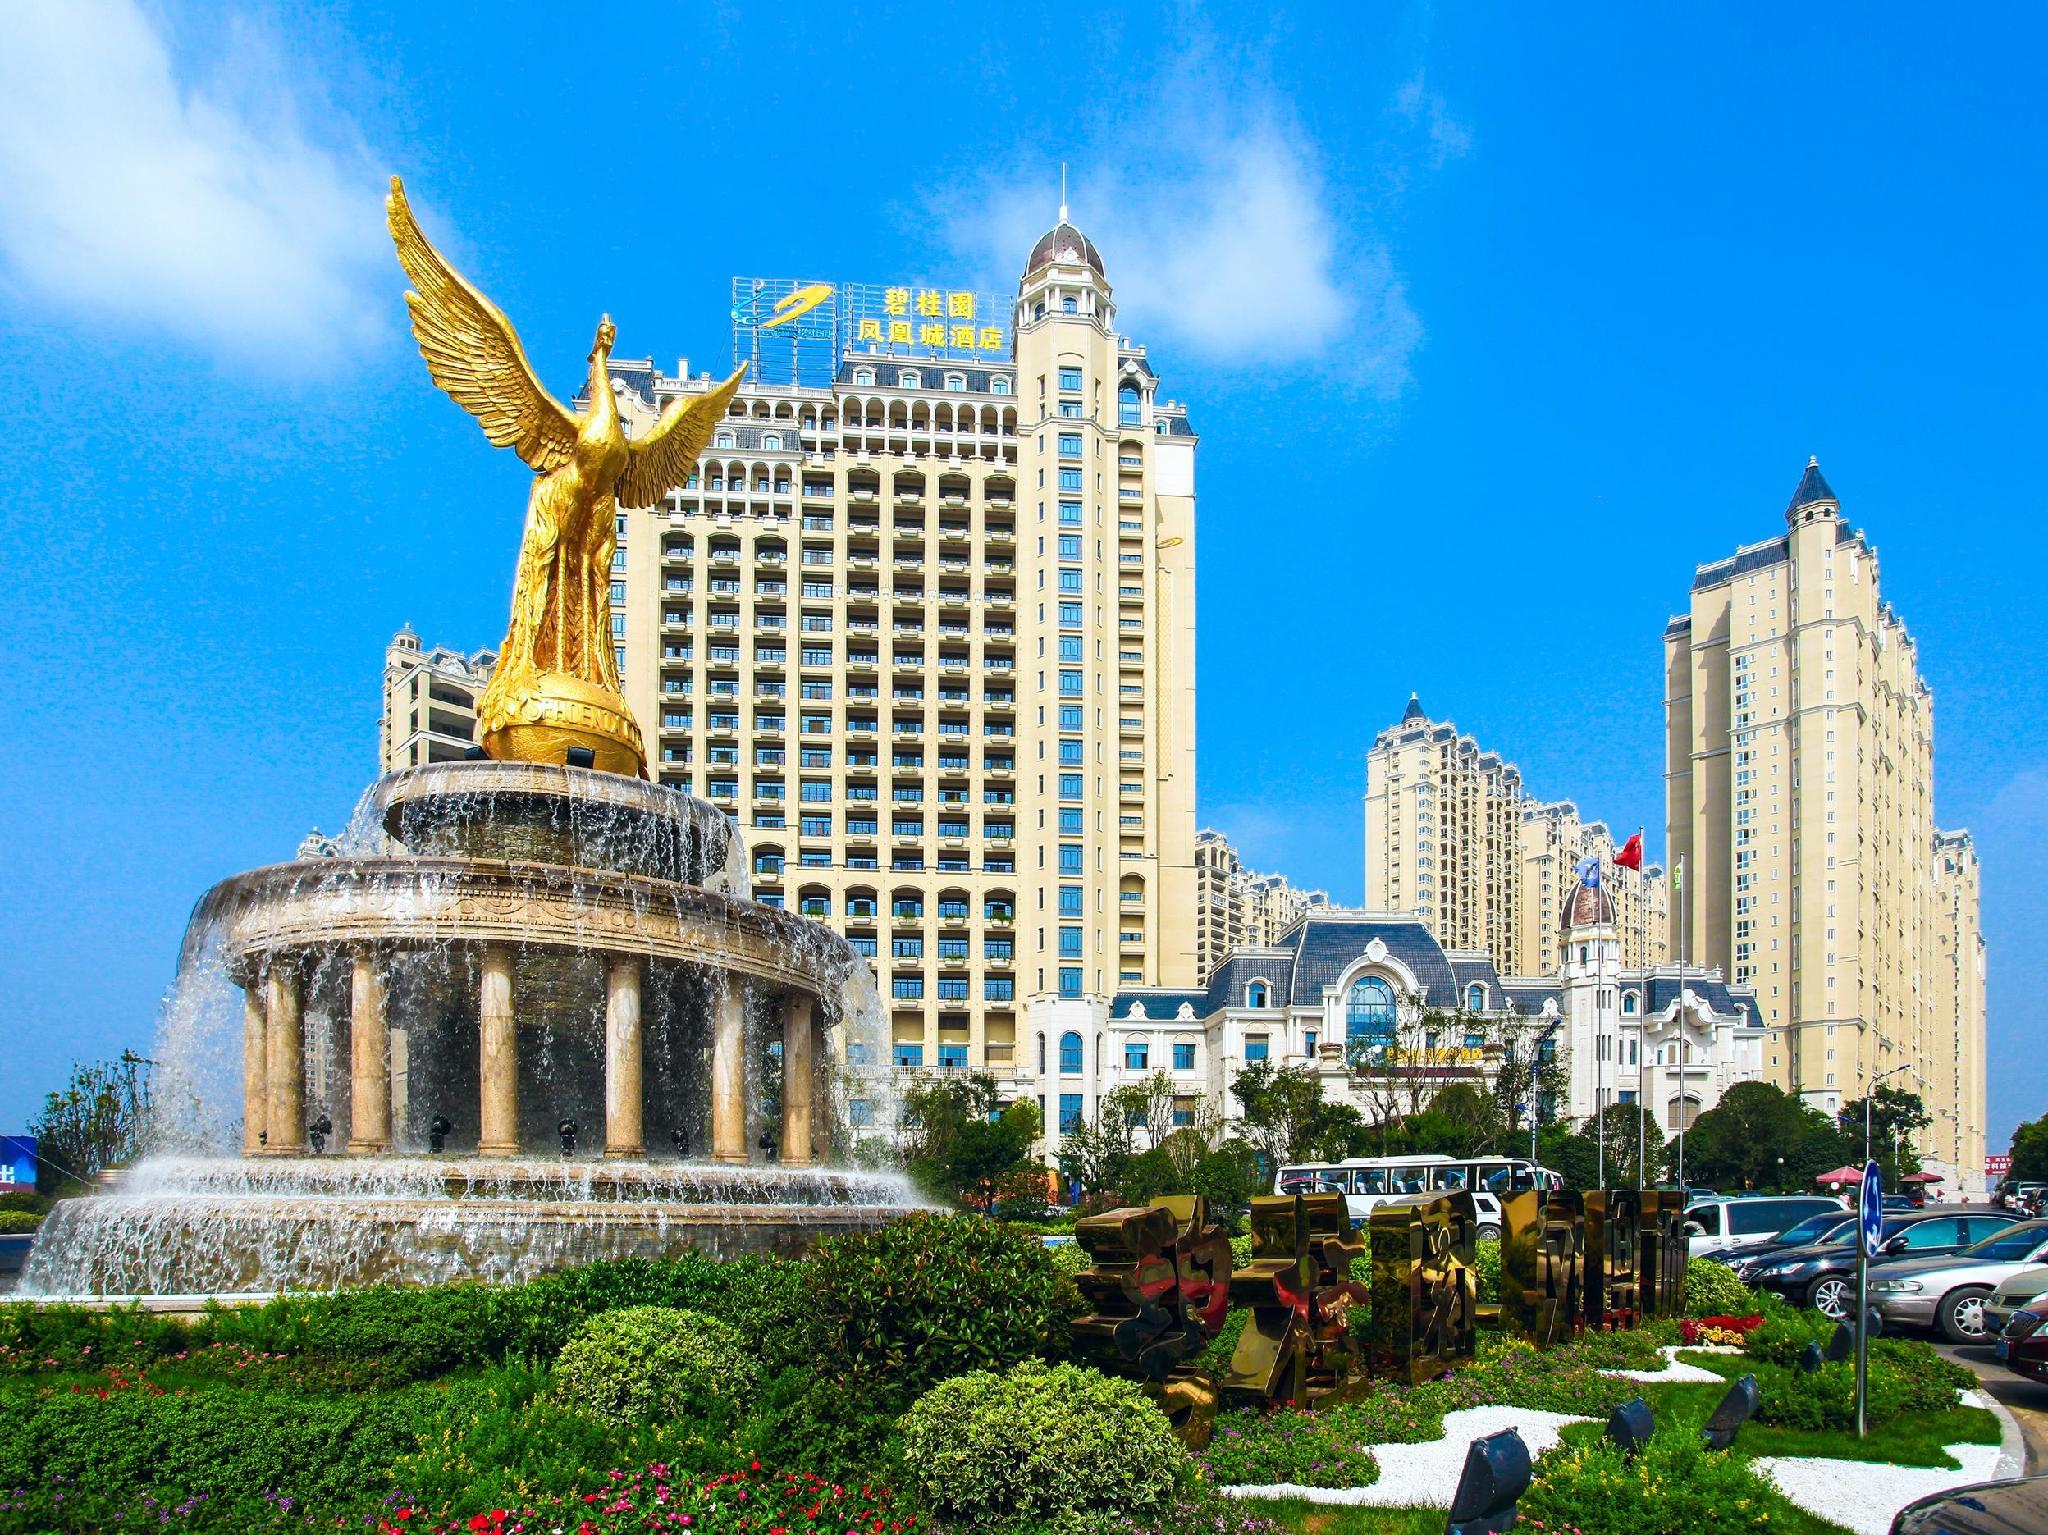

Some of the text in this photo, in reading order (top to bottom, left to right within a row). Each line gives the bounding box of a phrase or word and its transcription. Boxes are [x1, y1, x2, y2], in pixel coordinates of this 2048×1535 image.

[885, 287, 974, 319] 碧桂园
[858, 319, 1003, 350] 凤凰城酒店
